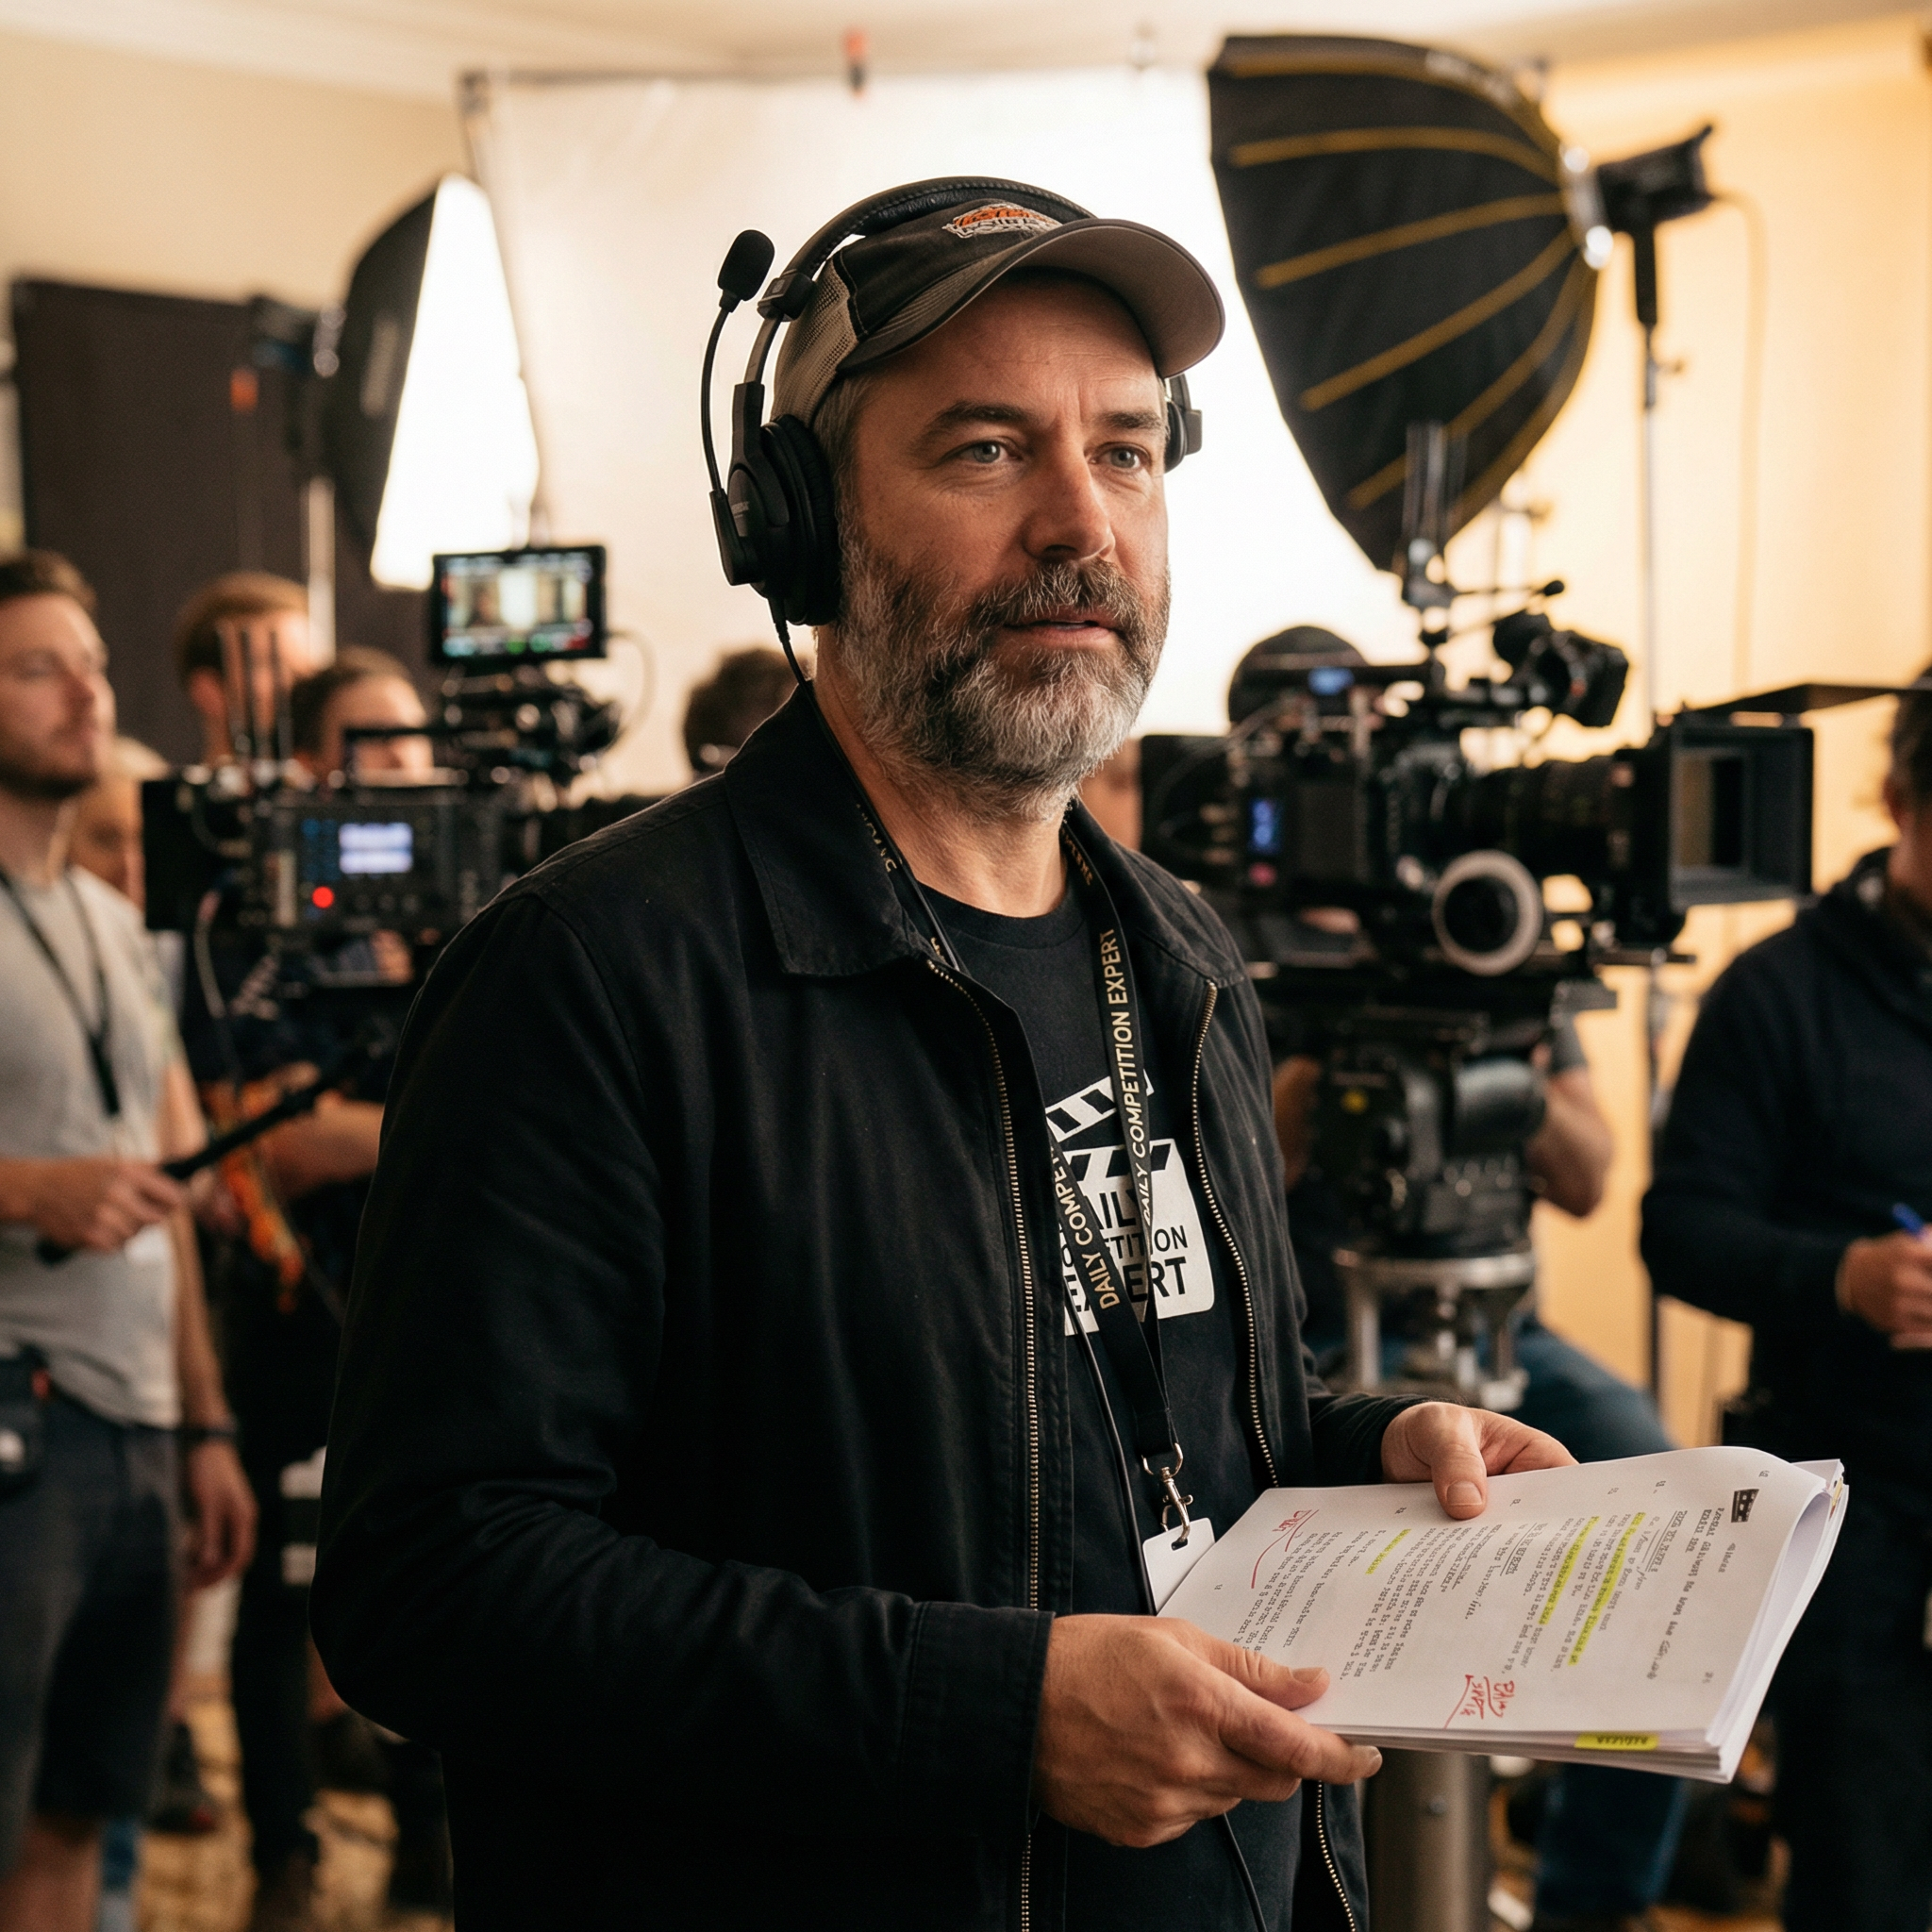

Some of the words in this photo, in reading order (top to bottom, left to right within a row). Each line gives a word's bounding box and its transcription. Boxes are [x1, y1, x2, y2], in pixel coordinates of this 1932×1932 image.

[1099, 928, 1129, 1005] EXPERT
[1110, 1011, 1147, 1158] COMPETITION
[1134, 1163, 1150, 1226] DAILY
[1081, 1252, 1122, 1310] DAILY
